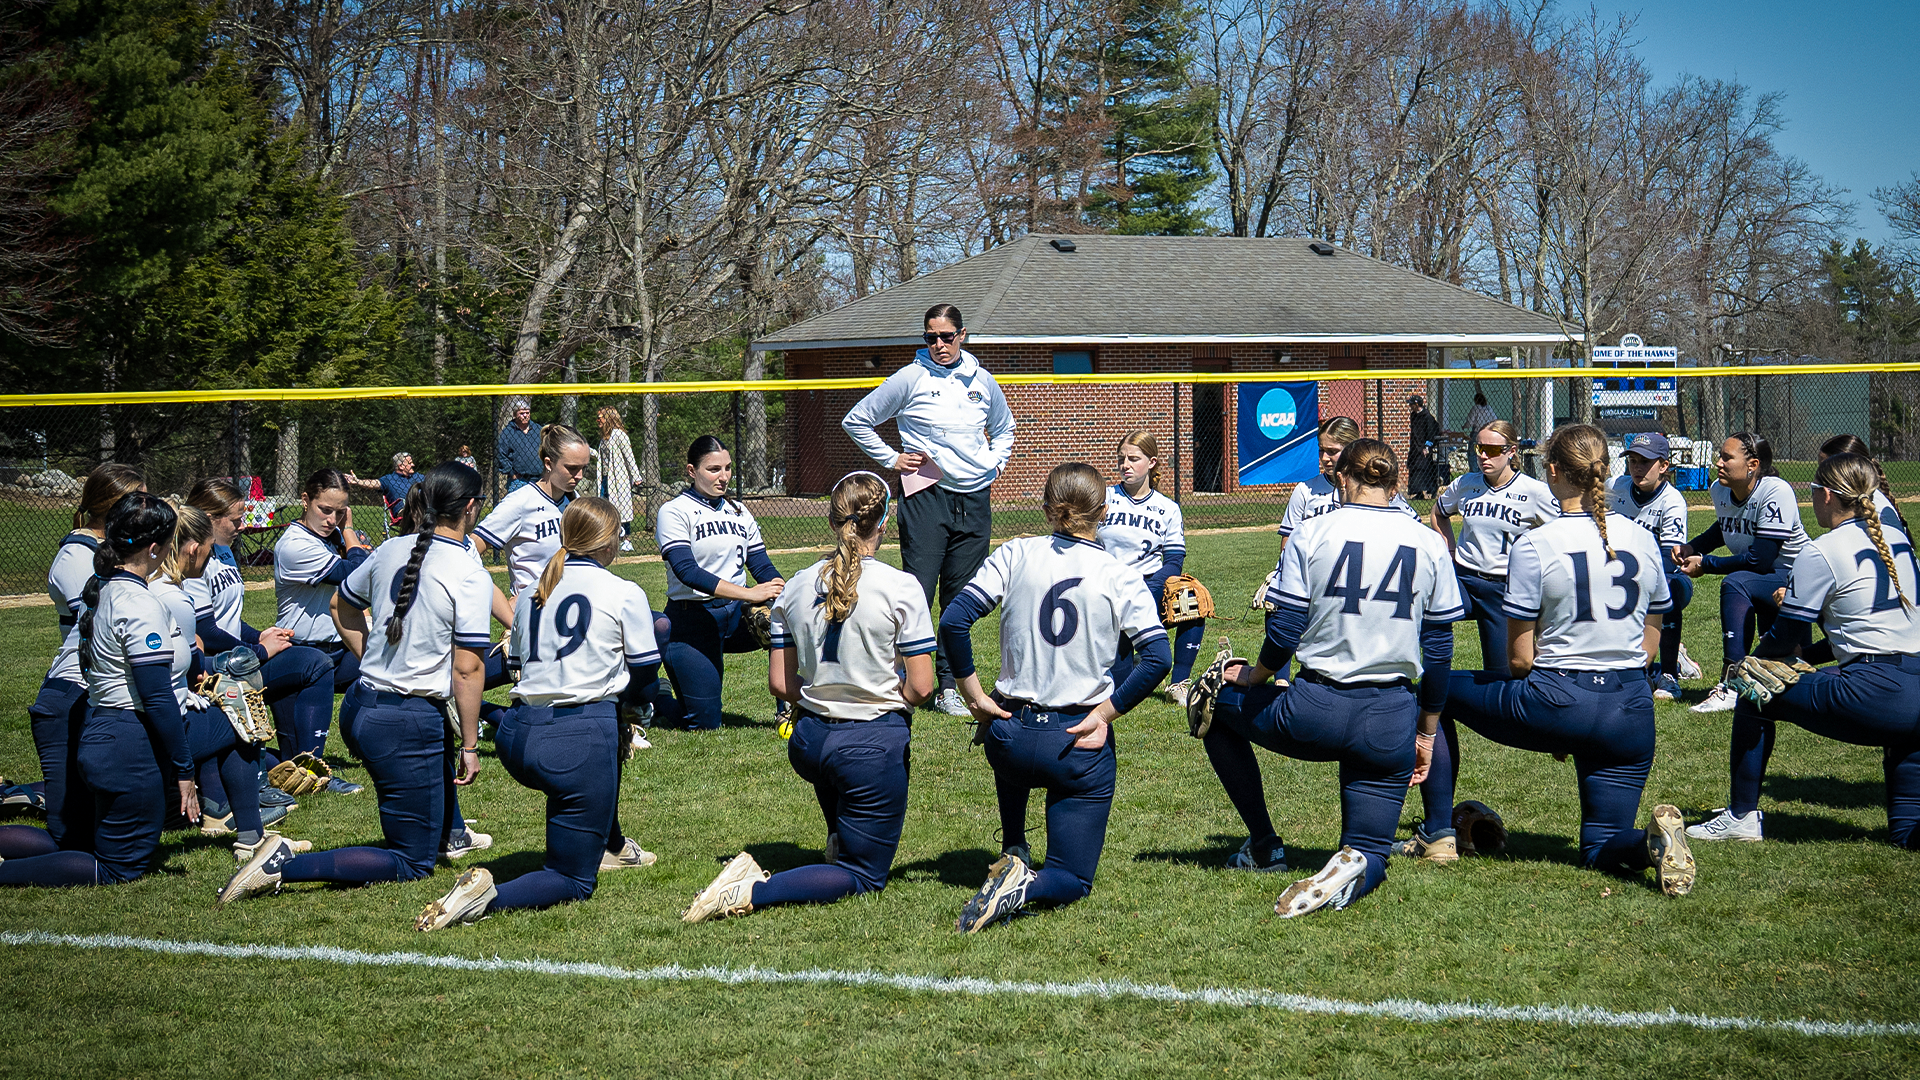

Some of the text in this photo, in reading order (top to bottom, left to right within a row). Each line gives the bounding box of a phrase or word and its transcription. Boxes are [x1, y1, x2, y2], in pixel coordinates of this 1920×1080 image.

[1260, 412, 1296, 428] NCAA
[1104, 512, 1165, 538] HAWKS
[1464, 501, 1522, 528] HAWKS
[1764, 501, 1785, 525] SA
[695, 520, 747, 542] HAWKS
[735, 544, 746, 570] 3
[1137, 540, 1153, 561] 2
[211, 568, 245, 599] HAWK
[1323, 540, 1420, 621] 44
[1564, 549, 1640, 624] 13
[1039, 577, 1086, 647] 6
[527, 593, 592, 663] 19
